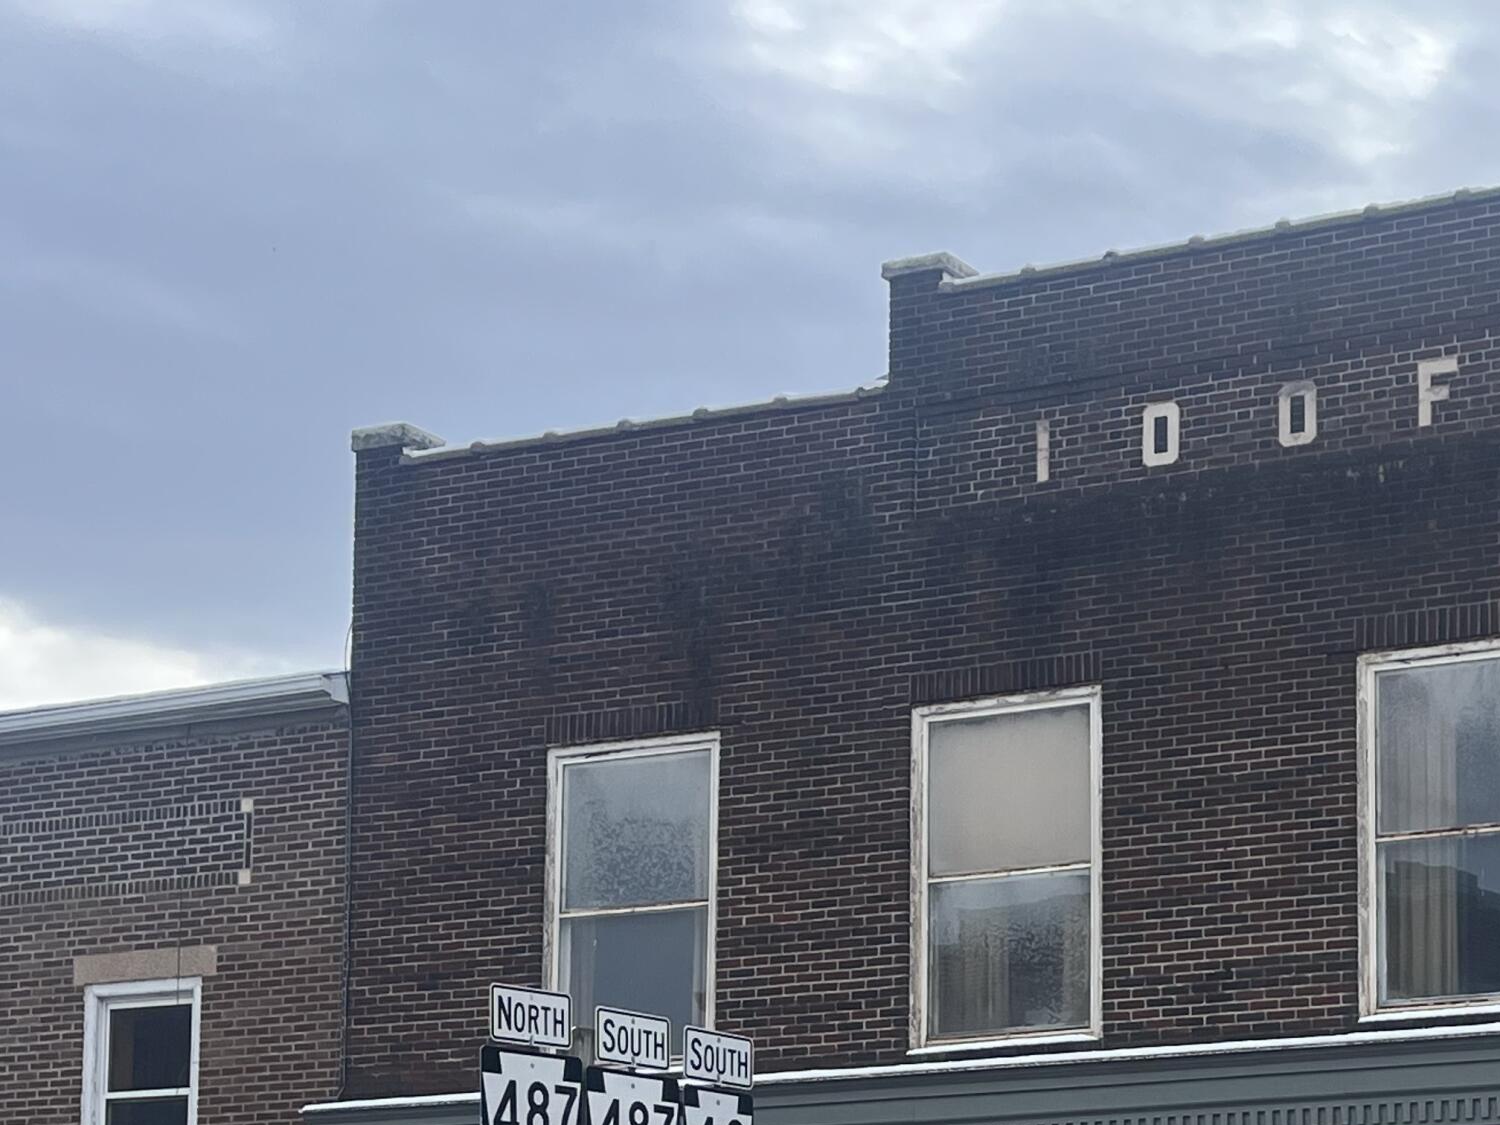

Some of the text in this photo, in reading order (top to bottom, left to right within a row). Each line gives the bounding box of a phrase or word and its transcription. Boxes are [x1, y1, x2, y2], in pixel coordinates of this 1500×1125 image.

[498, 995, 566, 1038] NORTH
[602, 1018, 665, 1060] SOUTH
[690, 1037, 749, 1079] SOUTH
